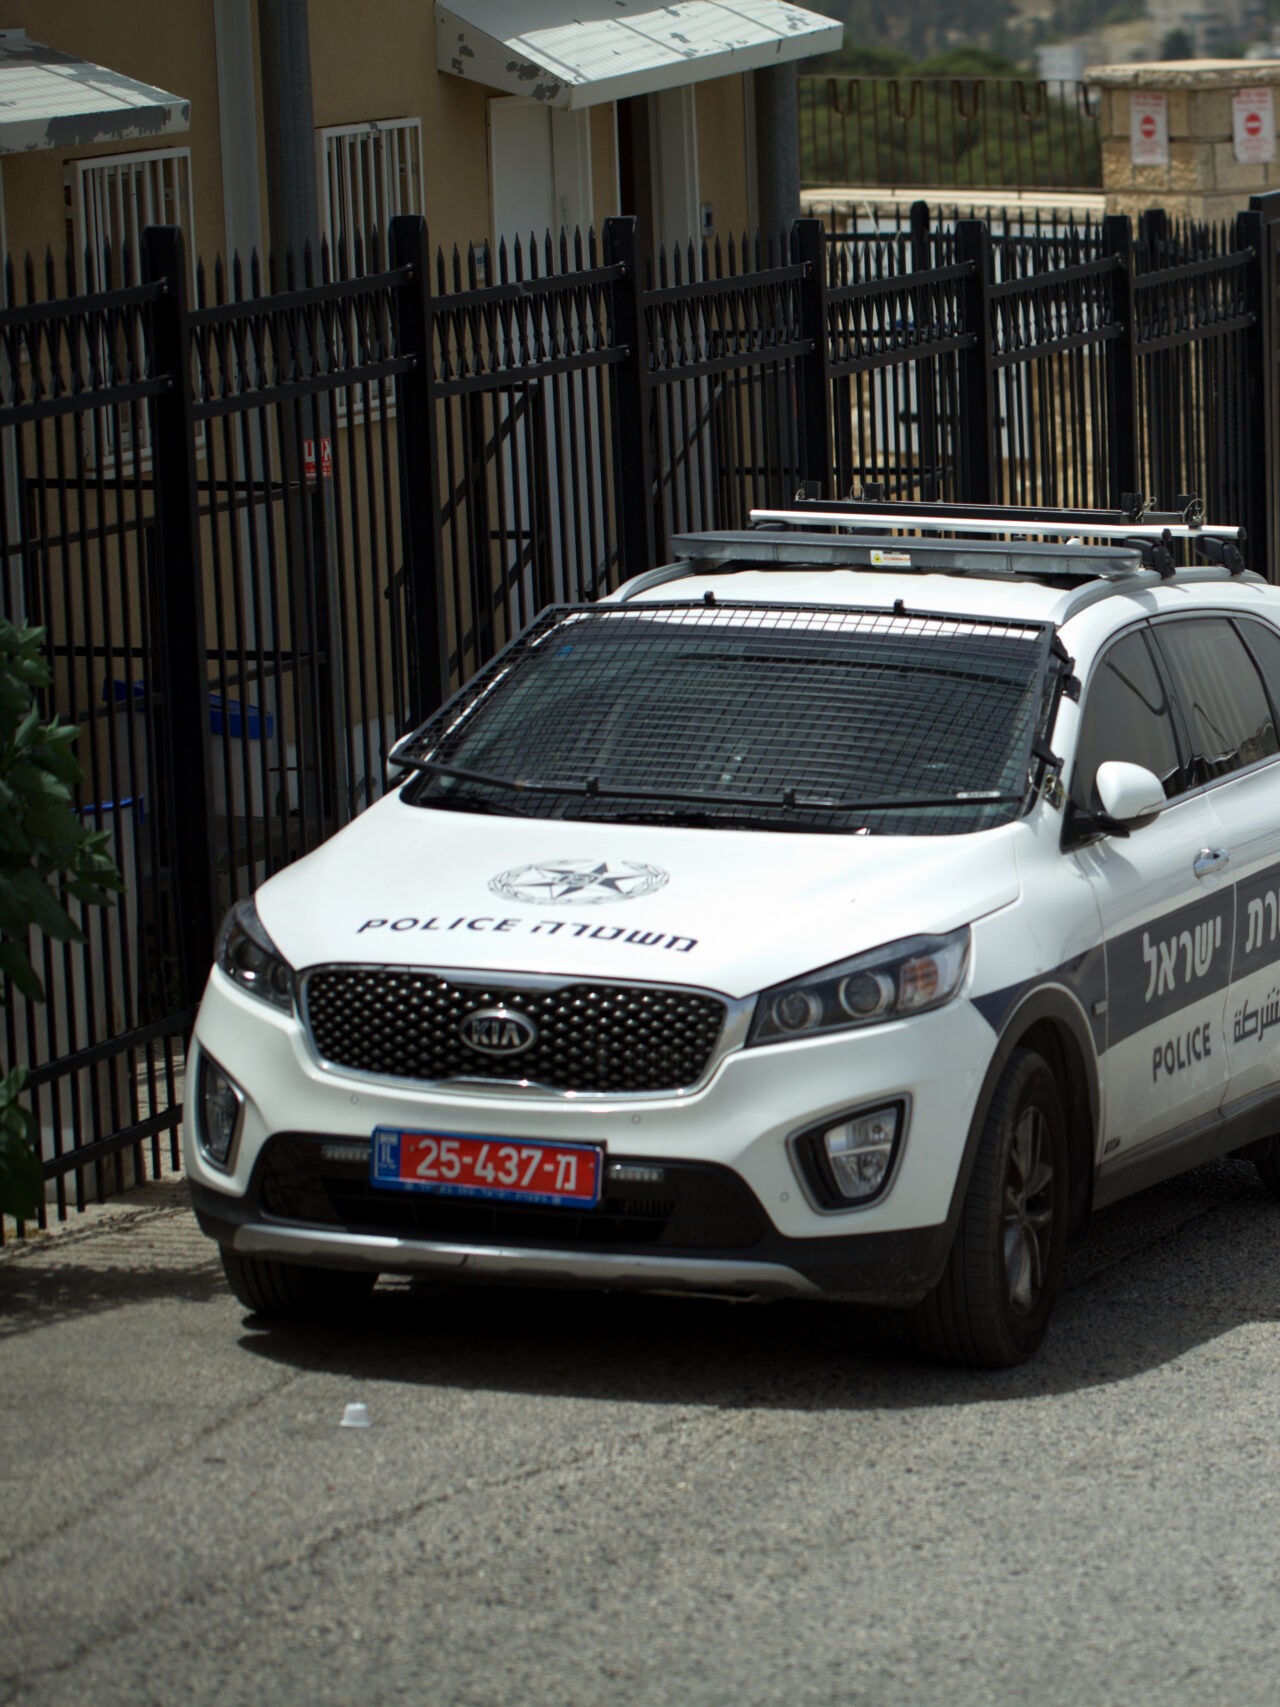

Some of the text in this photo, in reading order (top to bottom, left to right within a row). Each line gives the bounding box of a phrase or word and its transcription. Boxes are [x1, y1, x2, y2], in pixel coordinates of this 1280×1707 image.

[356, 917, 523, 934] POLICE
[530, 920, 699, 953] משטרה
[1142, 915, 1222, 1003] ישראל
[471, 1020, 521, 1046] KIA
[1152, 1022, 1211, 1082] POLICE
